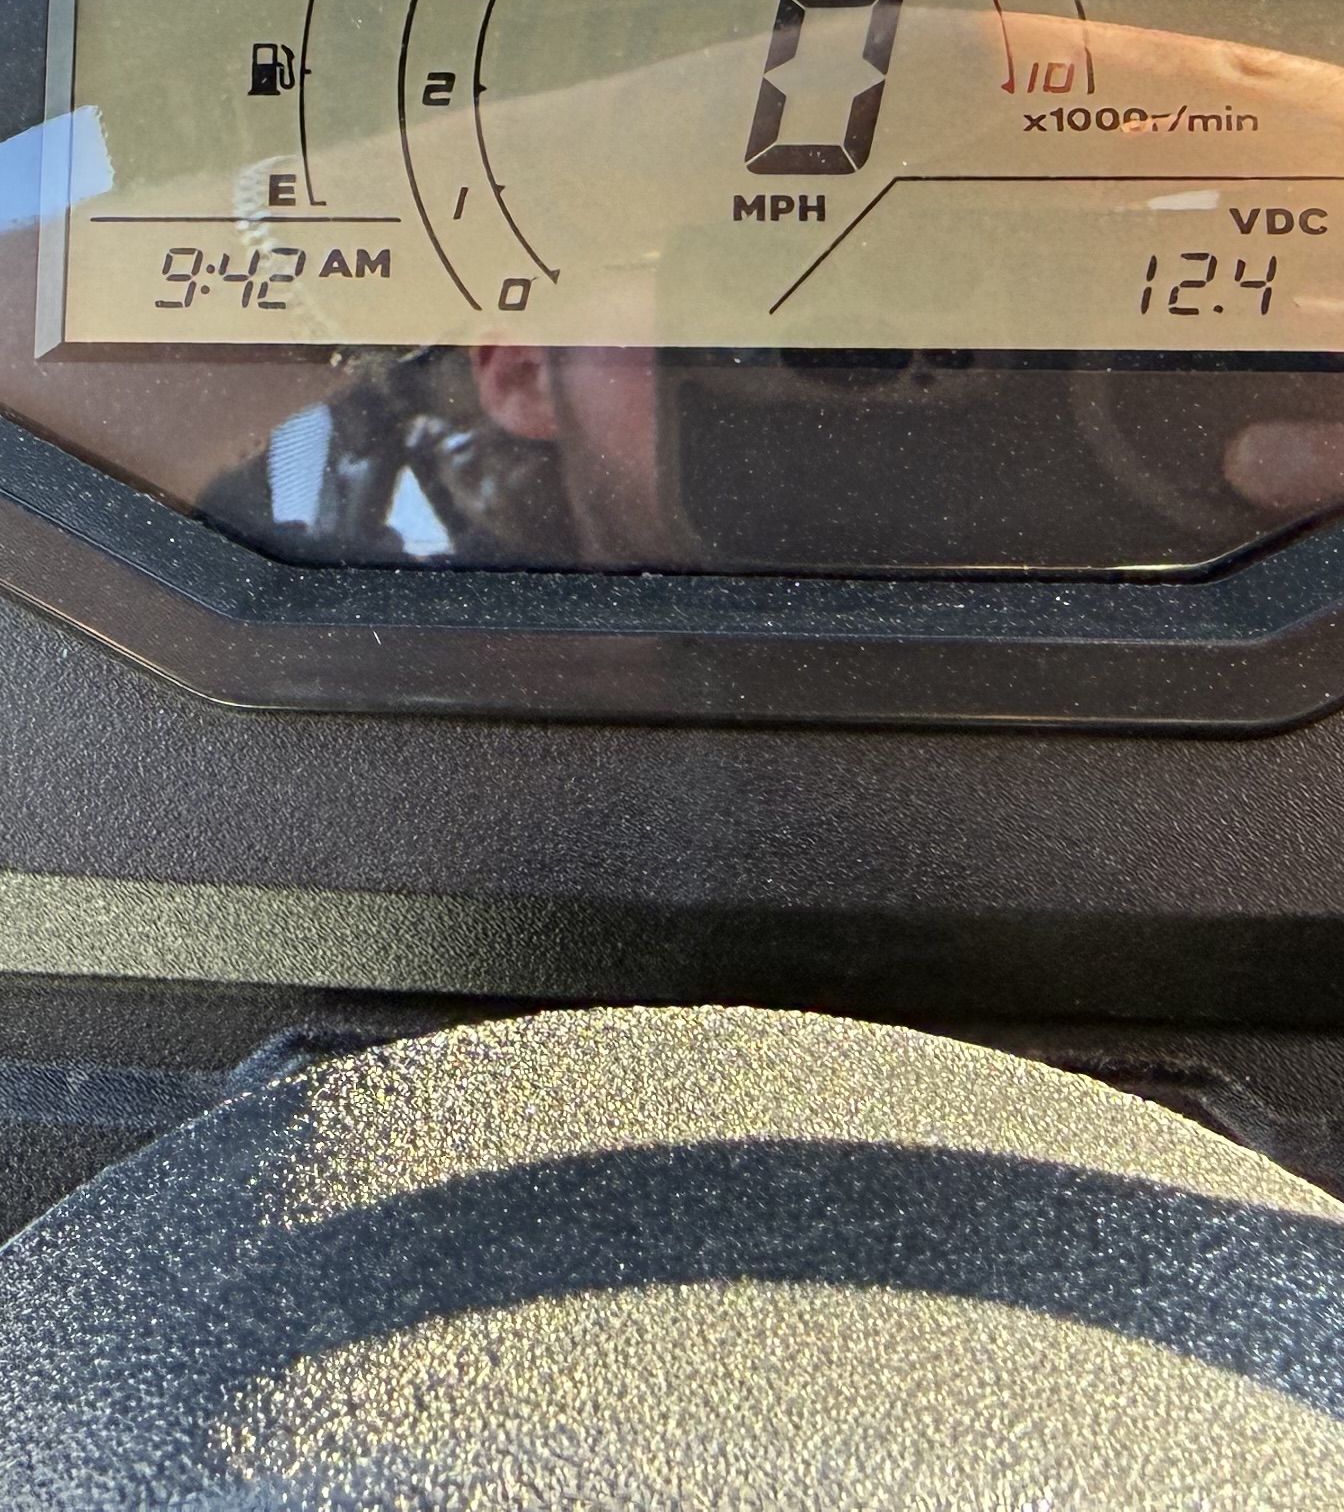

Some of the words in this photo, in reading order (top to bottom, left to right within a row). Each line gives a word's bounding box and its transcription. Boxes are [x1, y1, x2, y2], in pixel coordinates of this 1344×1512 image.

[421, 72, 456, 105] 2
[1025, 61, 1074, 94] 10
[268, 174, 297, 206] E
[452, 186, 469, 220] 1
[732, 195, 826, 222] MPH
[1229, 207, 1329, 236] VDC
[154, 247, 306, 310] 9:42
[318, 248, 392, 279] AM
[496, 276, 531, 310] 0
[1139, 252, 1278, 316] 12.4
